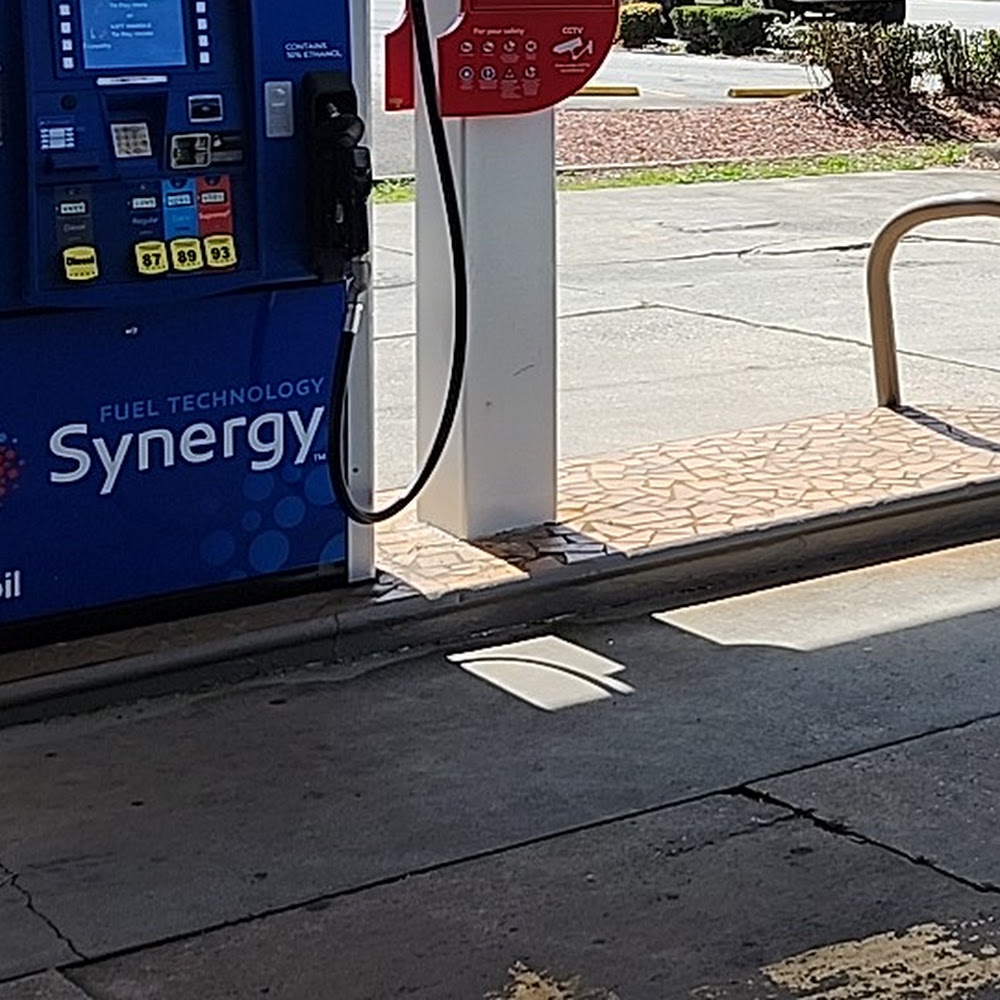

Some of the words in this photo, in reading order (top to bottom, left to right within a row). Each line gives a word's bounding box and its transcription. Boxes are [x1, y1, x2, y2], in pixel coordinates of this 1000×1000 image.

[473, 27, 487, 35] For
[487, 28, 503, 36] your
[503, 27, 525, 36] safety
[561, 26, 584, 35] CCTV
[142, 253, 162, 266] 87
[177, 249, 197, 263] 89
[210, 246, 231, 260] 93
[101, 401, 159, 423] FUEL
[167, 377, 325, 413] TECHNOLOGY
[50, 405, 325, 495] Synergy
[0, 570, 21, 599] il
